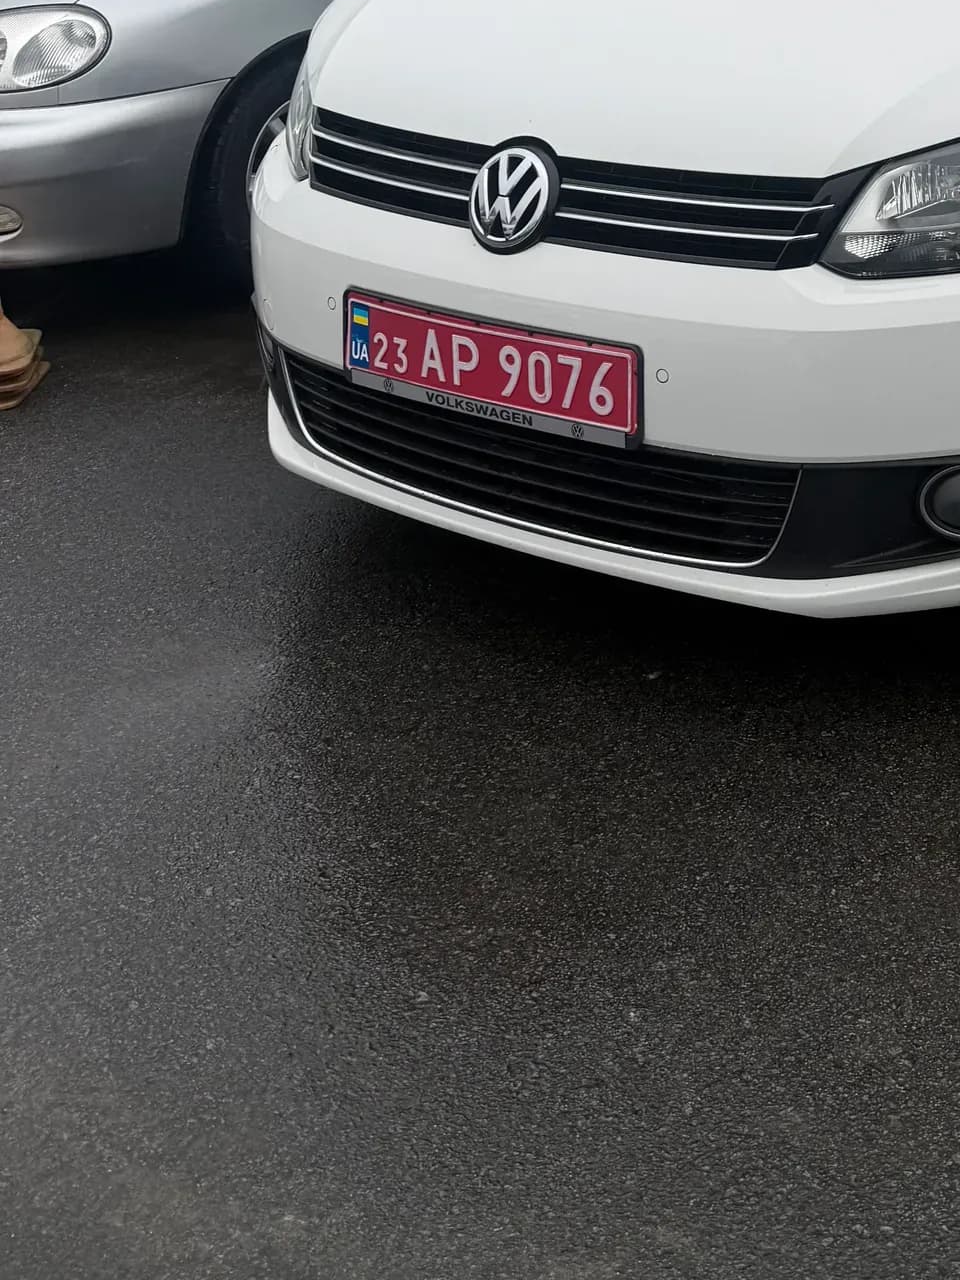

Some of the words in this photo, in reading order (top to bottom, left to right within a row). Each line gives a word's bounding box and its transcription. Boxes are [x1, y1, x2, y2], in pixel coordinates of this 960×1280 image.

[352, 340, 369, 362] UA
[373, 332, 408, 374] 23
[421, 328, 480, 386] AP
[499, 345, 614, 416] 9076
[425, 391, 533, 426] VOLKSWAGEN
